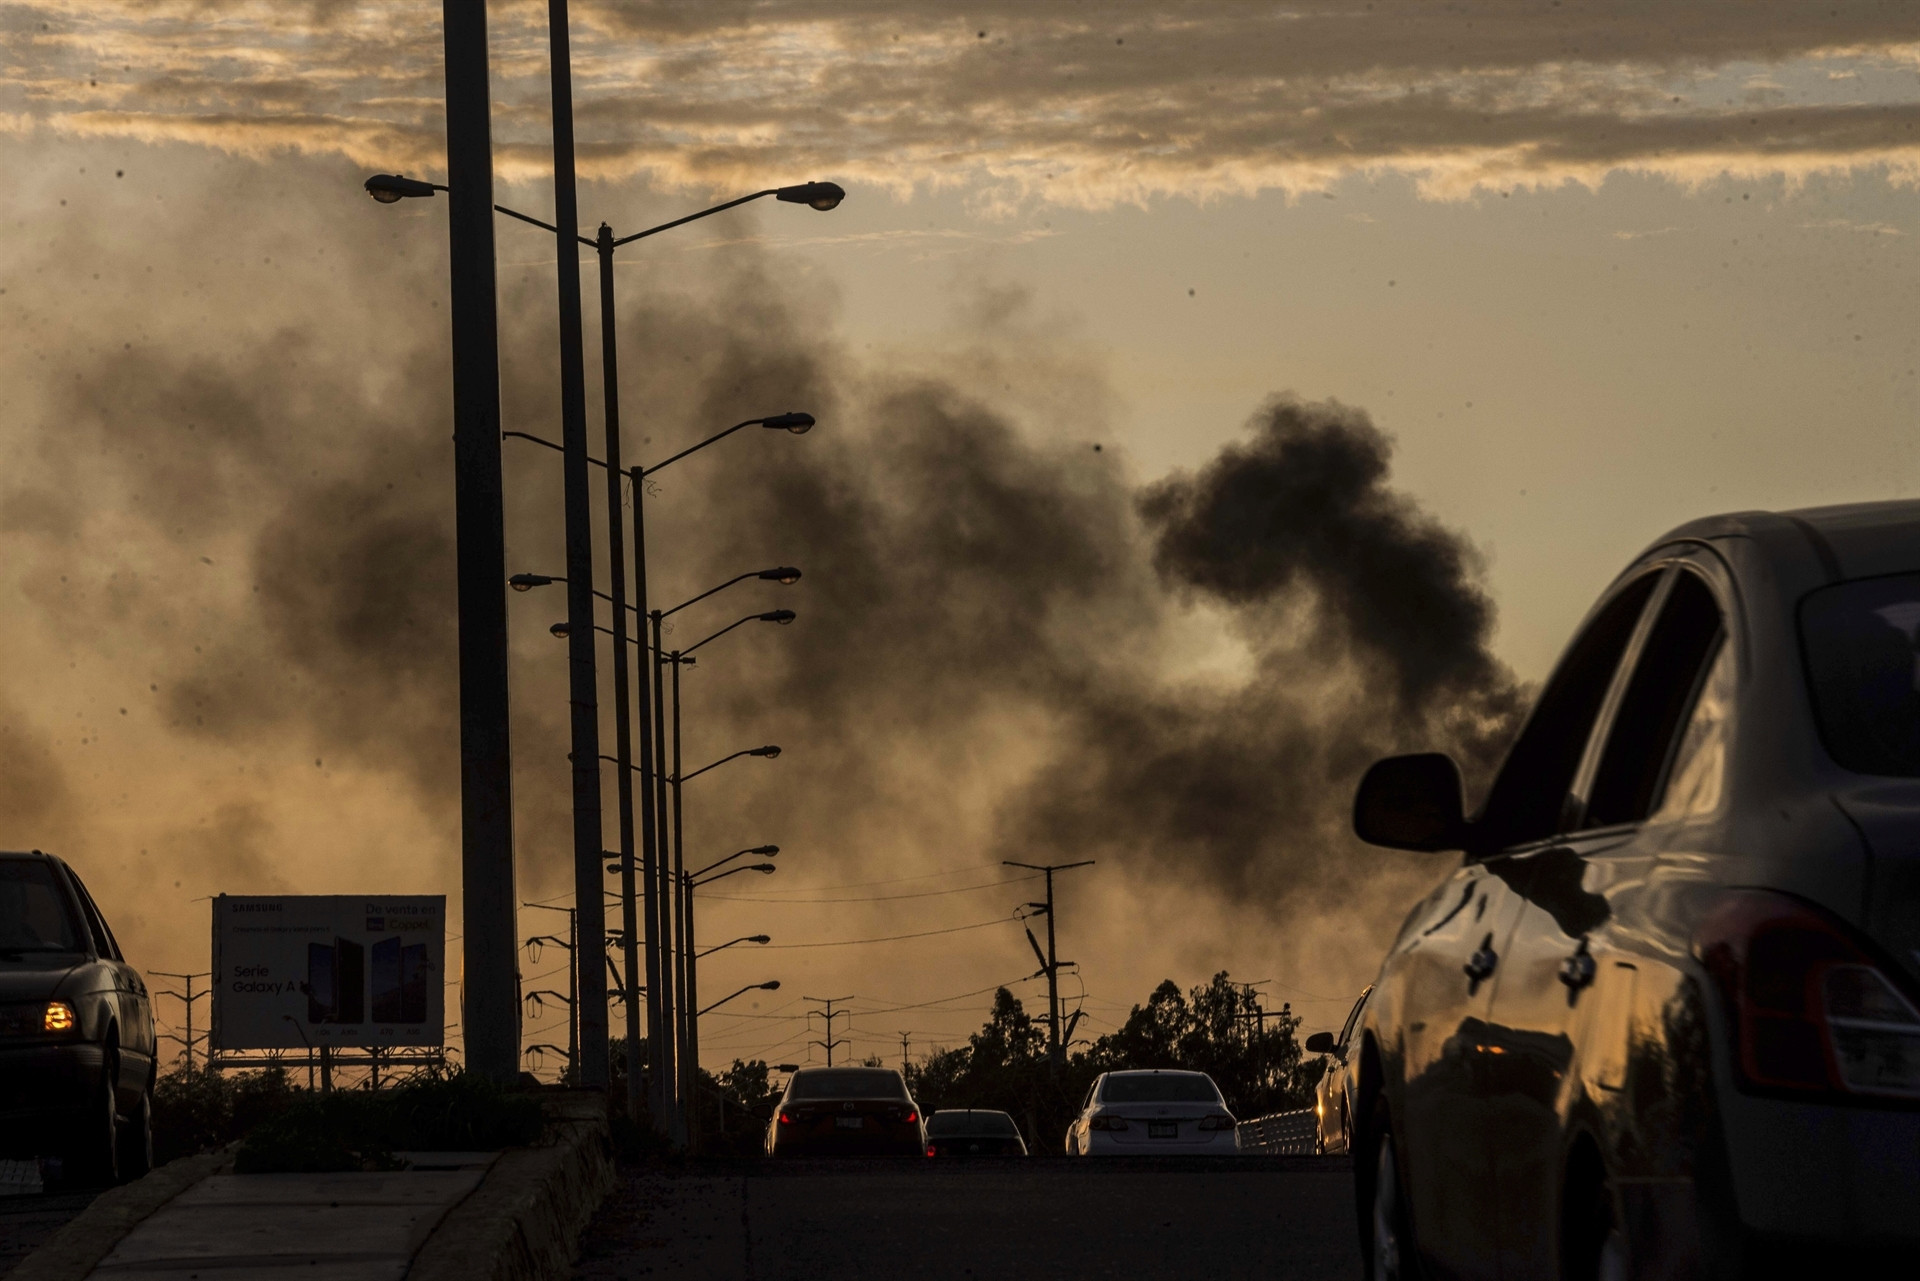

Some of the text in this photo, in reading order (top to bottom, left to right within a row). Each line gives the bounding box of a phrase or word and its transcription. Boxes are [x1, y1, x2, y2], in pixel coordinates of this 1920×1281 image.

[232, 903, 283, 913] SAMSUNG
[366, 903, 436, 914] De venta en
[390, 918, 428, 932] Coppel
[234, 964, 269, 977] Serie
[232, 980, 295, 997] Galaxy A
